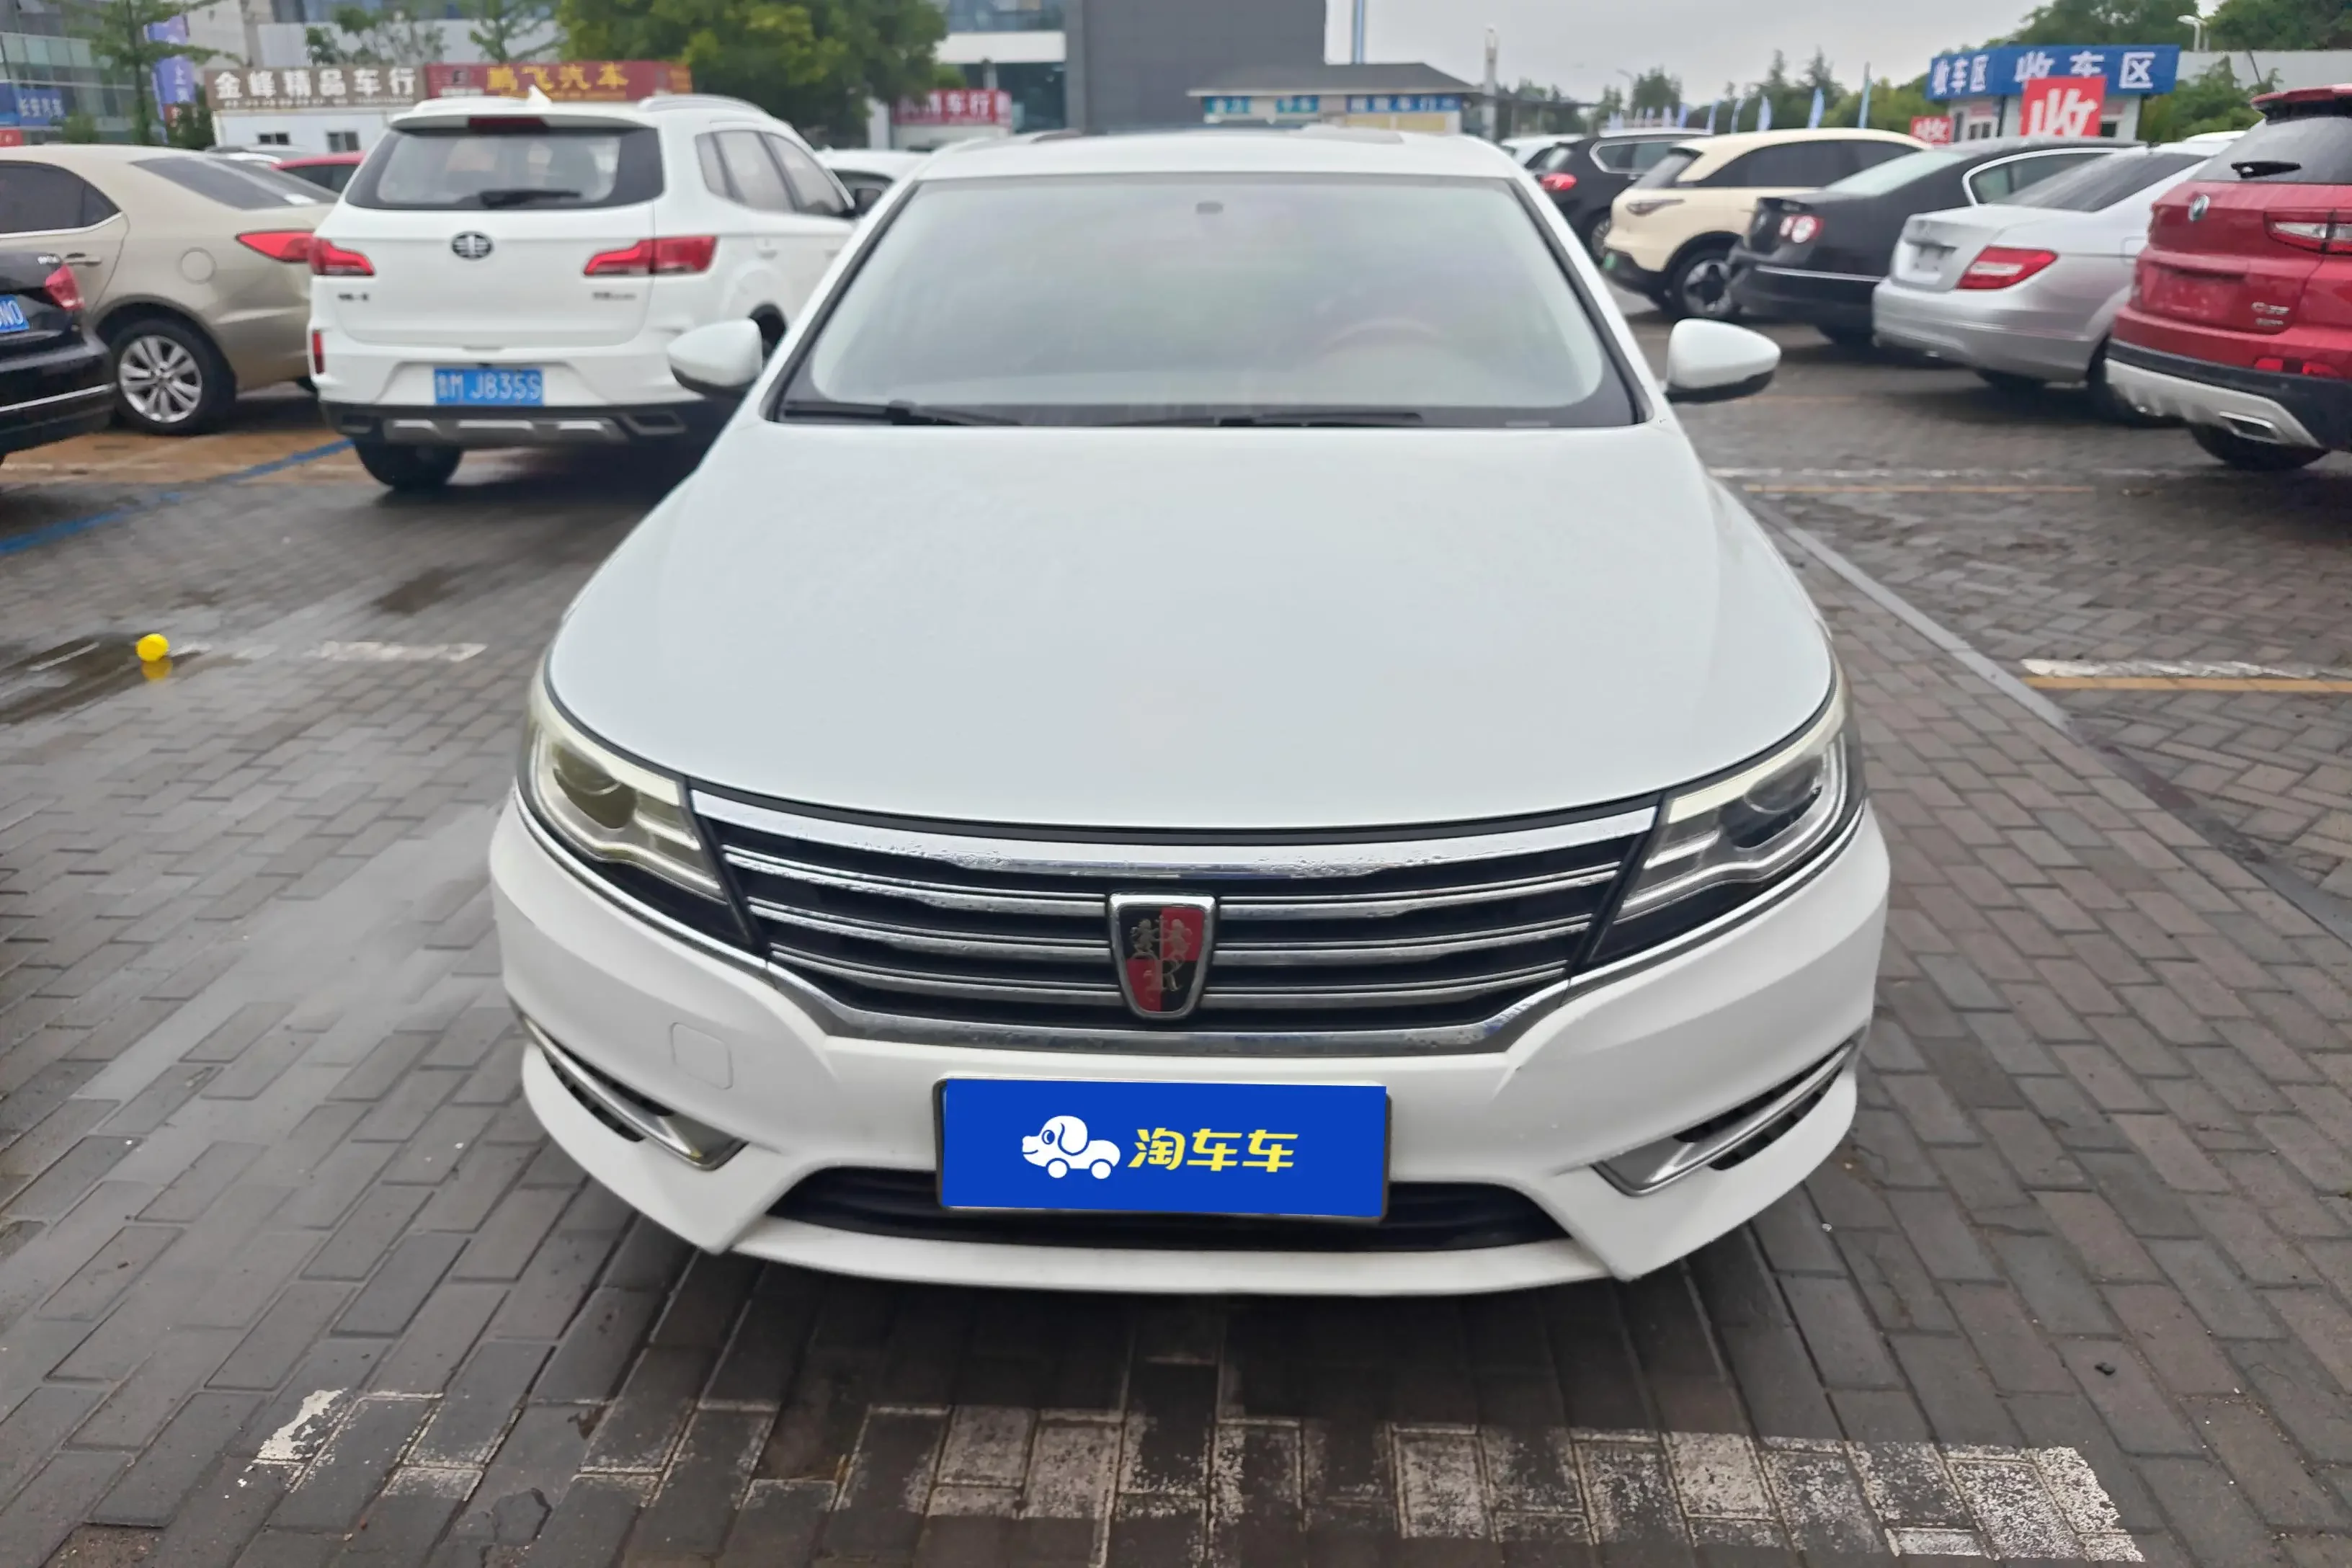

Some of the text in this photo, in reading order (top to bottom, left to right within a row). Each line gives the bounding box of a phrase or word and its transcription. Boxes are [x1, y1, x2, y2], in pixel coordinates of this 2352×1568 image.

[215, 67, 416, 99] 金峰精品车行
[2013, 51, 2157, 89] 收车区
[2028, 88, 2098, 137] 收
